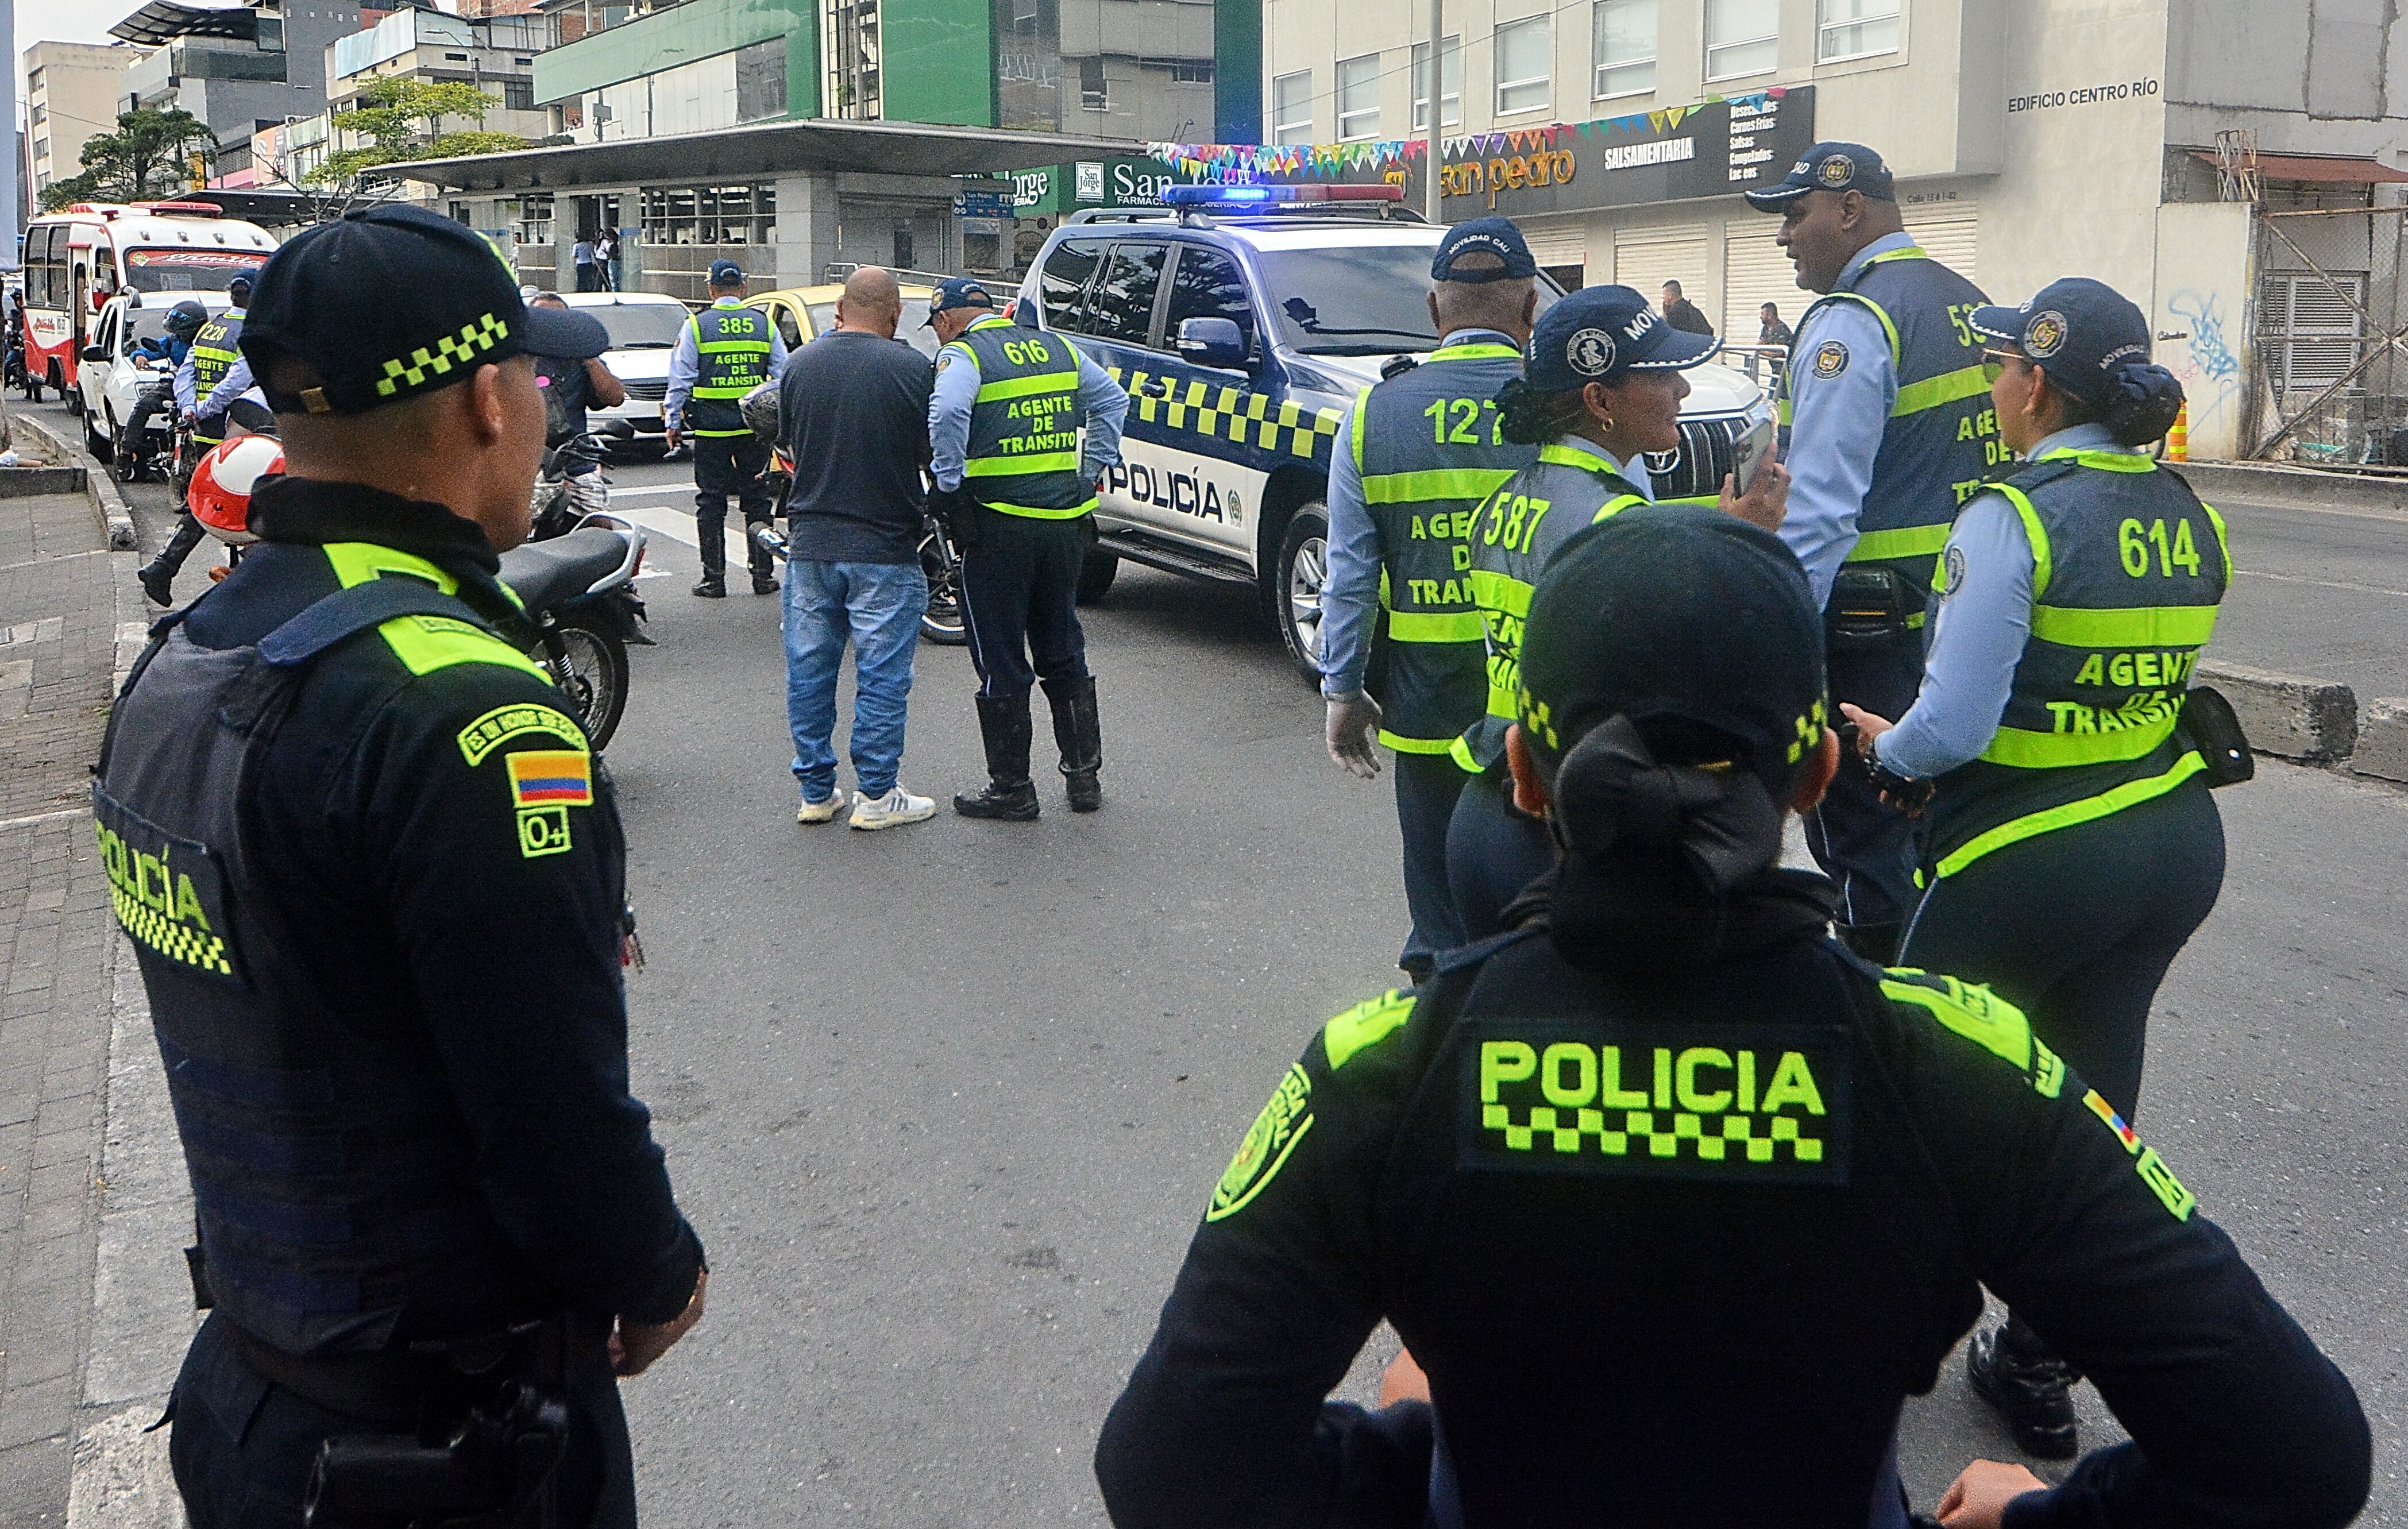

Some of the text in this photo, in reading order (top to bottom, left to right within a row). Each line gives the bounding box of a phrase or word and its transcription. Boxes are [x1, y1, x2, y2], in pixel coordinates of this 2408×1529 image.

[2008, 76, 2158, 113] EDIFICIO CENTRO RÍO
[1730, 120, 1755, 134] Carnes
[1604, 137, 1694, 170] SALSAMENTARIA
[1730, 136, 1755, 150] Salsas
[1729, 148, 1773, 165] Congelados
[1079, 175, 1100, 191] Jorge
[1085, 169, 1098, 180] San
[1114, 164, 1173, 196] San
[1488, 137, 1576, 210] pedro
[1117, 196, 1170, 206] FARMAC
[1448, 234, 1510, 255] MOVILIDAD CALI
[201, 324, 227, 341] 228
[718, 317, 754, 334] 385
[715, 353, 760, 364] AGENTE
[1004, 339, 1049, 365] 616
[195, 358, 224, 372] AGENTE
[201, 370, 211, 381] DE
[731, 365, 748, 374] DE
[1007, 395, 1072, 419] AGENTE
[1033, 415, 1054, 433] DE
[1957, 408, 2002, 442] AGE
[998, 431, 1076, 454] TRANSITO
[1109, 462, 1223, 524] POLICÍA
[1411, 511, 1469, 540] AGE
[1484, 492, 1551, 554] 587
[1452, 545, 1471, 572] D
[2118, 518, 2201, 578] 614
[2074, 648, 2199, 686] AGENT
[95, 818, 212, 932] POLICÍA
[1480, 1041, 1826, 1115] POLICIA
